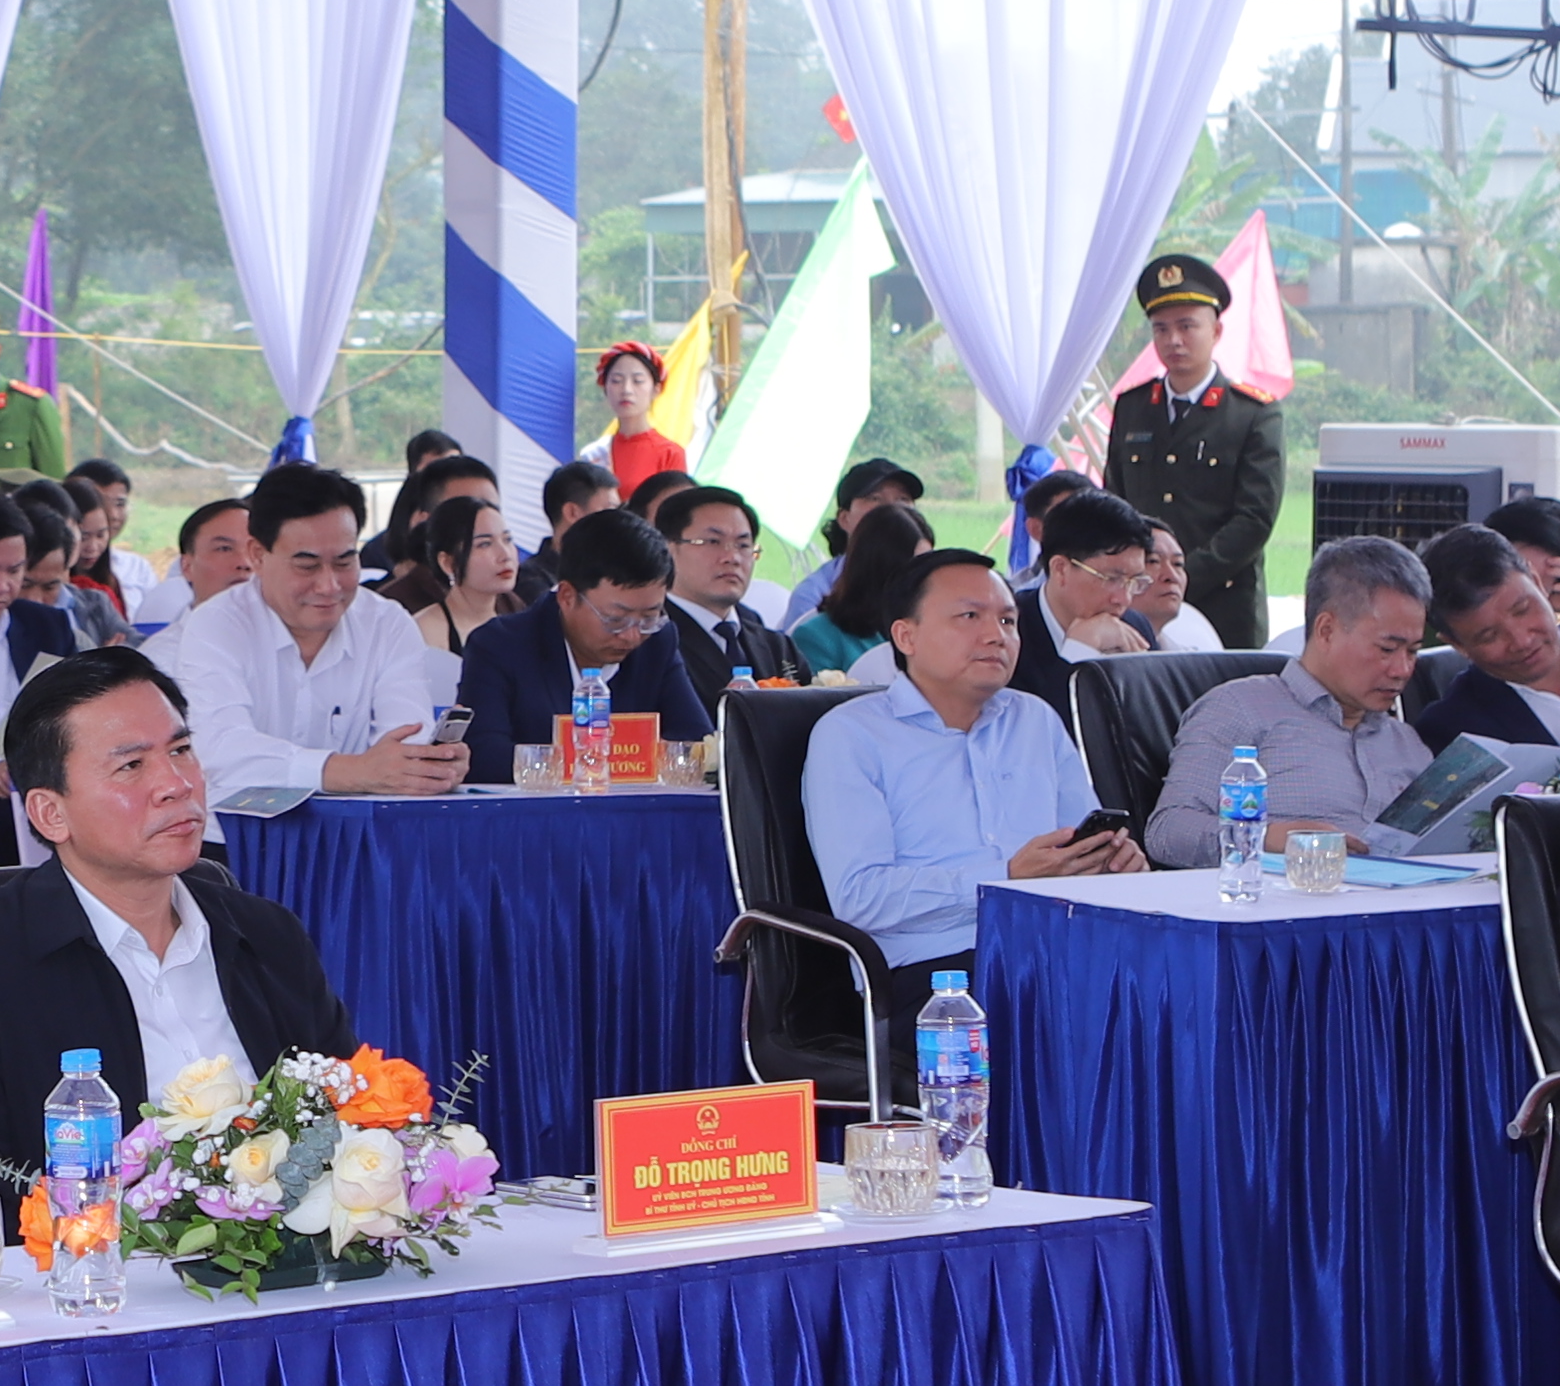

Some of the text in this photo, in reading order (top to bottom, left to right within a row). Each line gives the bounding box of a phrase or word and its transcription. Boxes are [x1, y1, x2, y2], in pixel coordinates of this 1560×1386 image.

[1399, 436, 1446, 450] SAMMAX
[681, 1134, 737, 1154] ĐỒNG CHÍ
[634, 1150, 789, 1189] ĐỖ TRỌNG HƯNG
[698, 1186, 722, 1198] TRUNG
